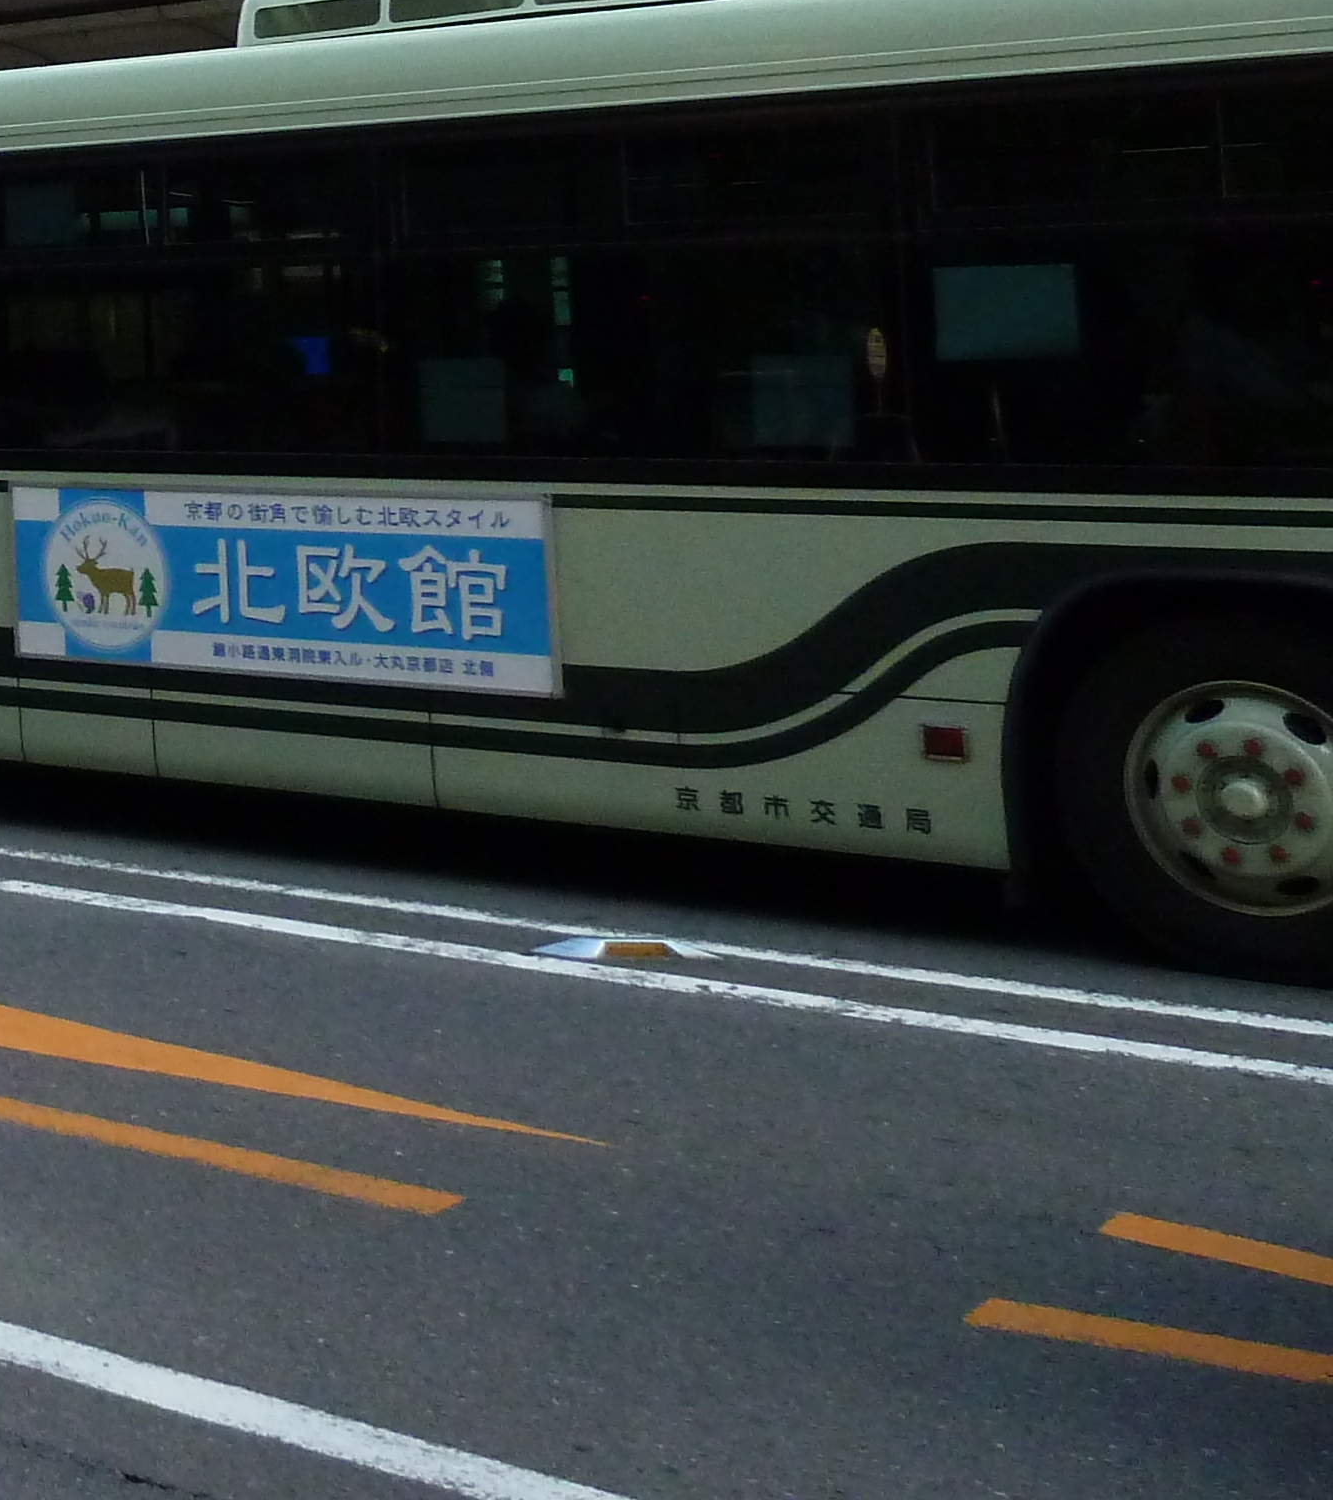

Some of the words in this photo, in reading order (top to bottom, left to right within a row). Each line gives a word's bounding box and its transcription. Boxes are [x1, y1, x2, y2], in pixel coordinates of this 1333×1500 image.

[184, 499, 511, 530] 京都の街角で愉しむ北欧スタイル
[192, 537, 507, 642] 北欧館
[674, 786, 933, 837] 京都市交通局
